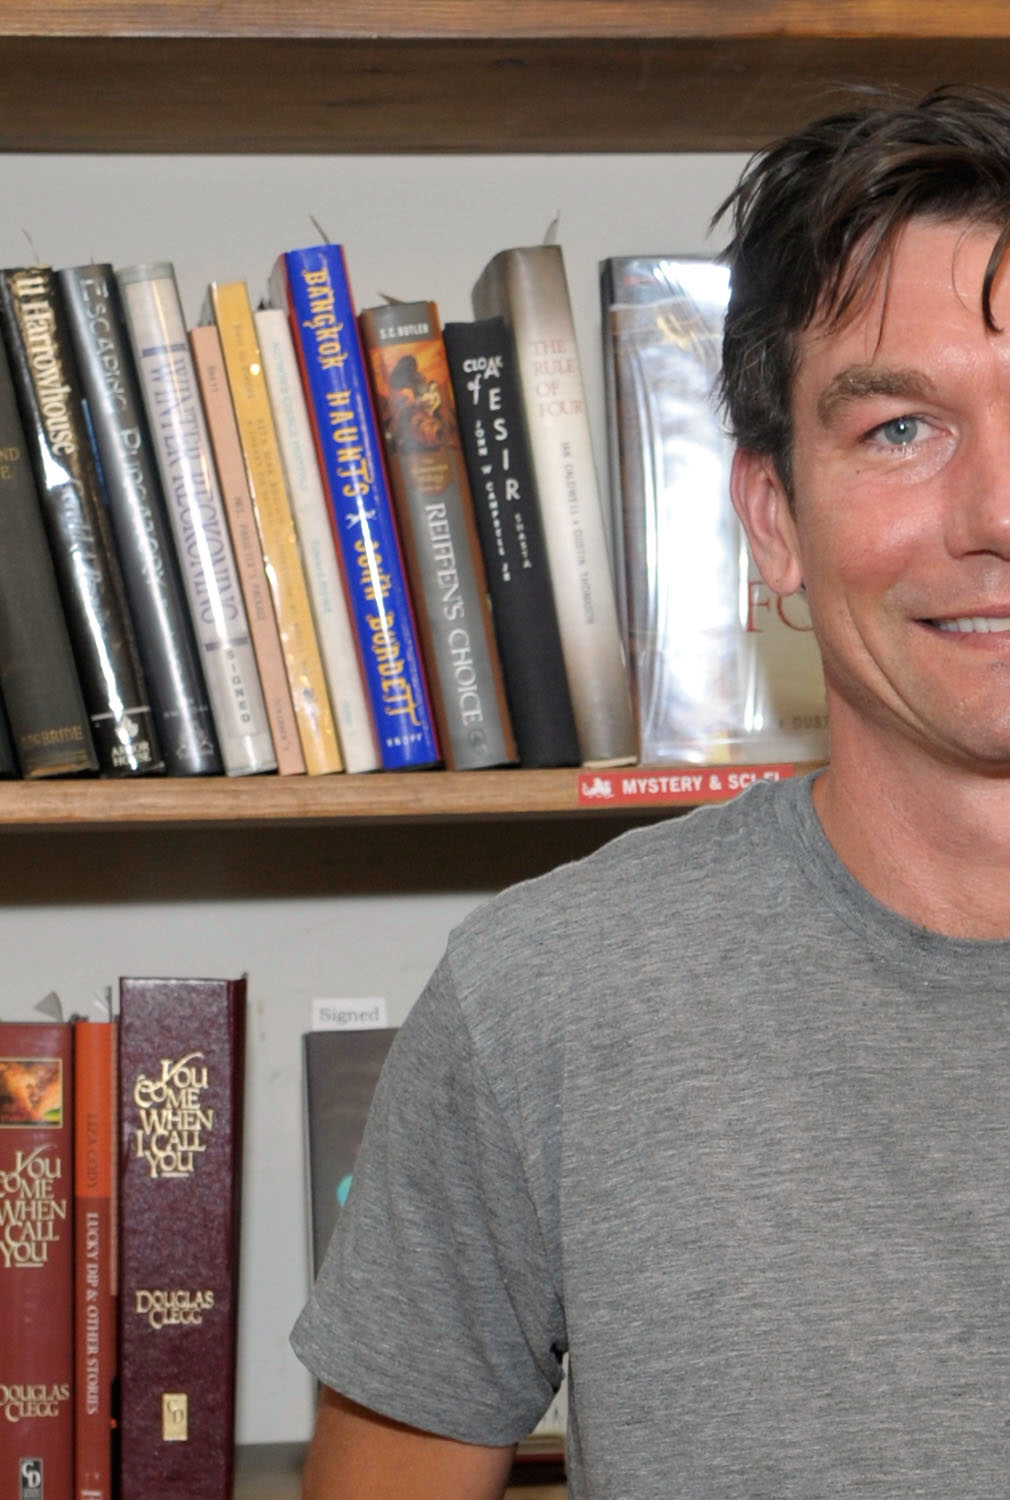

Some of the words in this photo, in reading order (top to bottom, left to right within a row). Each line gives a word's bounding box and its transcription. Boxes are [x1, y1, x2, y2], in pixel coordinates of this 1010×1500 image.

[80, 277, 128, 411] ESCAPING
[531, 338, 568, 356] THE
[22, 300, 76, 456] Harrowhouse
[533, 359, 578, 377] RULE
[302, 268, 349, 370] BANGKOK
[326, 389, 371, 498] HAUNTS
[466, 373, 482, 406] of
[535, 381, 562, 397] OF
[146, 357, 206, 467] WINTER
[537, 400, 585, 418] FOUR
[169, 468, 241, 627] RECKONING
[354, 538, 395, 601] JOHN
[425, 502, 466, 621] REIFFEN'S
[448, 628, 484, 727] CHOICE
[366, 607, 422, 727] BURDETT
[226, 650, 252, 724] SIGNED
[621, 774, 703, 795] MYSTERY
[708, 773, 723, 791] &
[318, 1006, 381, 1025] Signed
[138, 1108, 214, 1135] WHEN
[135, 1129, 145, 1158] I
[151, 1129, 207, 1158] CALL
[144, 1150, 194, 1179] YOU
[5, 1221, 60, 1249] CALL
[86, 1211, 99, 1260] LUCKY
[86, 1262, 99, 1289] DIP
[135, 1290, 215, 1314] DOUGLAS
[86, 1304, 100, 1357] OTHER
[149, 1308, 204, 1330] CLEGG
[86, 1359, 100, 1415] STORIES
[5, 1401, 60, 1423] CLEGG
